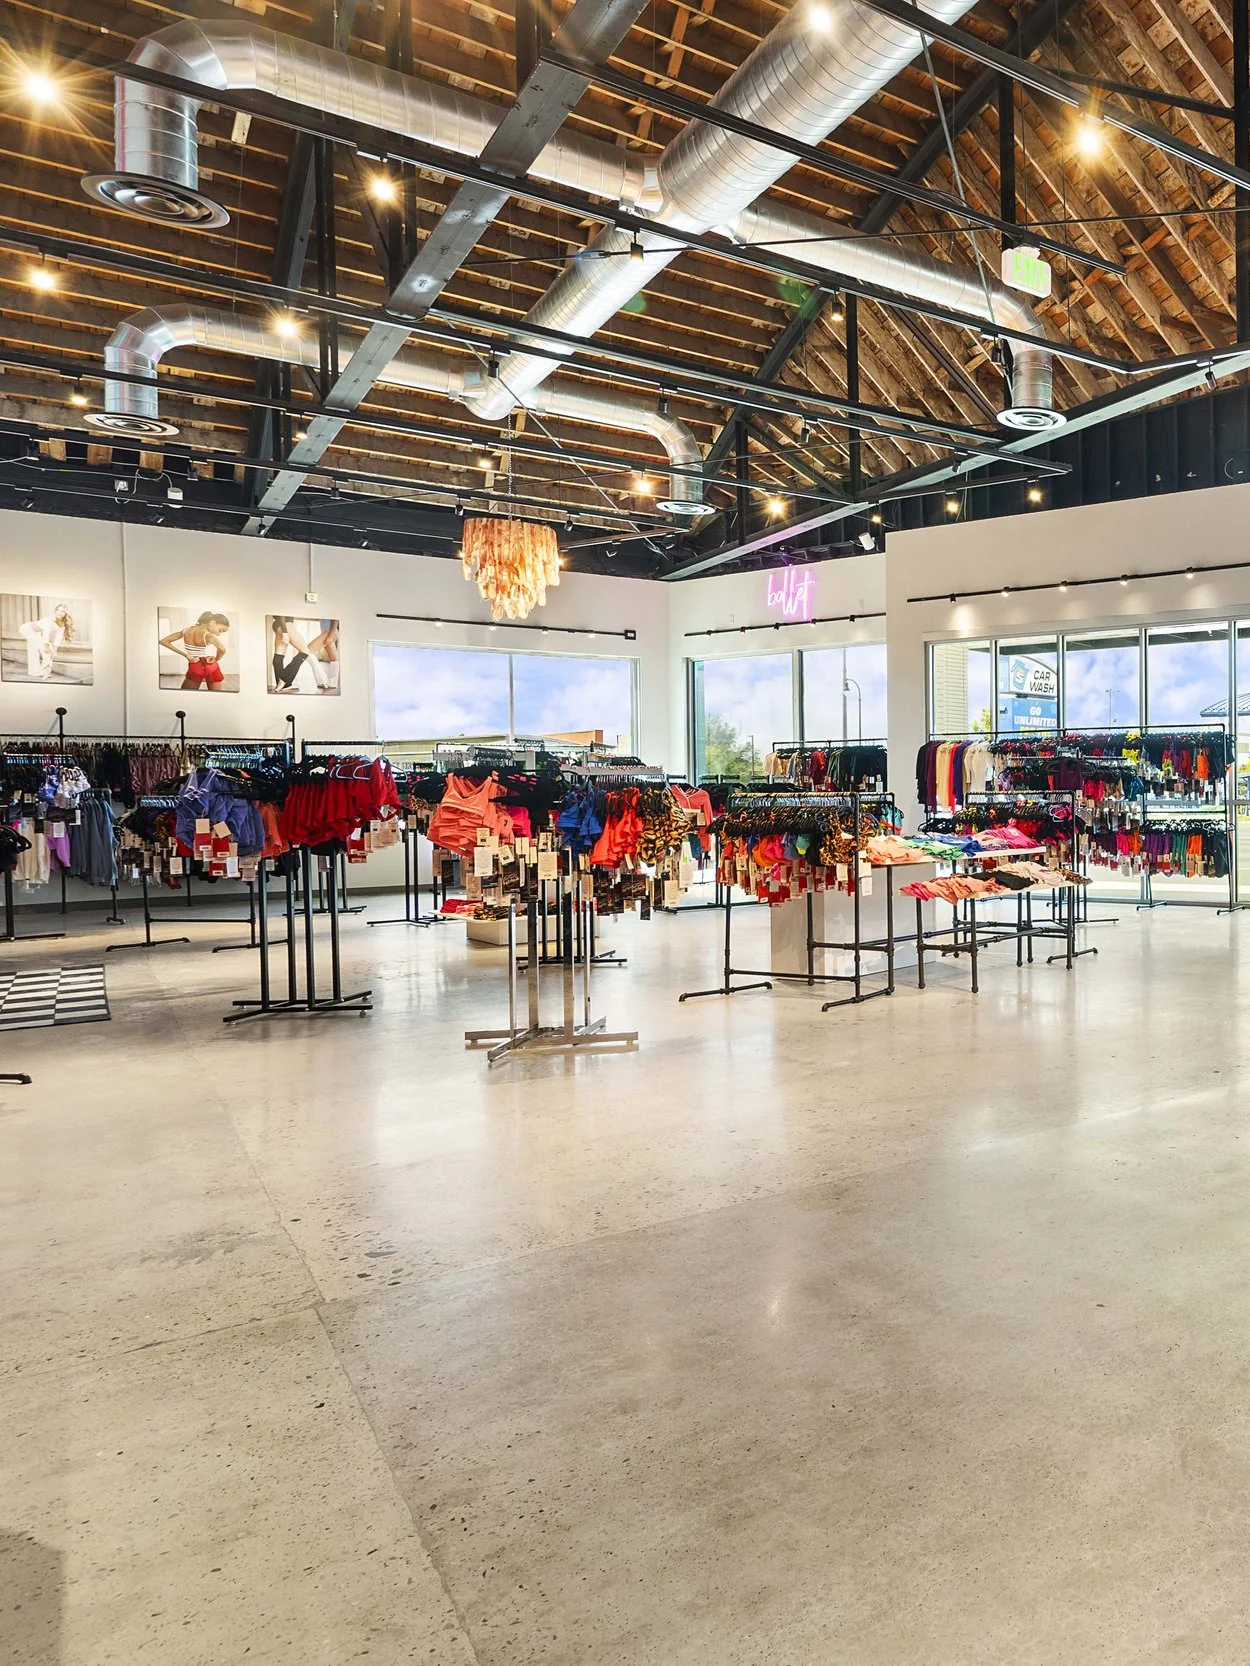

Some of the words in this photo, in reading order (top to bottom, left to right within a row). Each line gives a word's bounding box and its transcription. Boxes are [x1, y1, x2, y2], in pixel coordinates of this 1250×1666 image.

[1013, 251, 1045, 293] EXIT
[767, 568, 816, 621] ballet
[1033, 670, 1051, 682] CAR
[1029, 681, 1055, 694] WASH
[1030, 706, 1042, 716] GO
[1014, 715, 1057, 727] UNLIMITED
